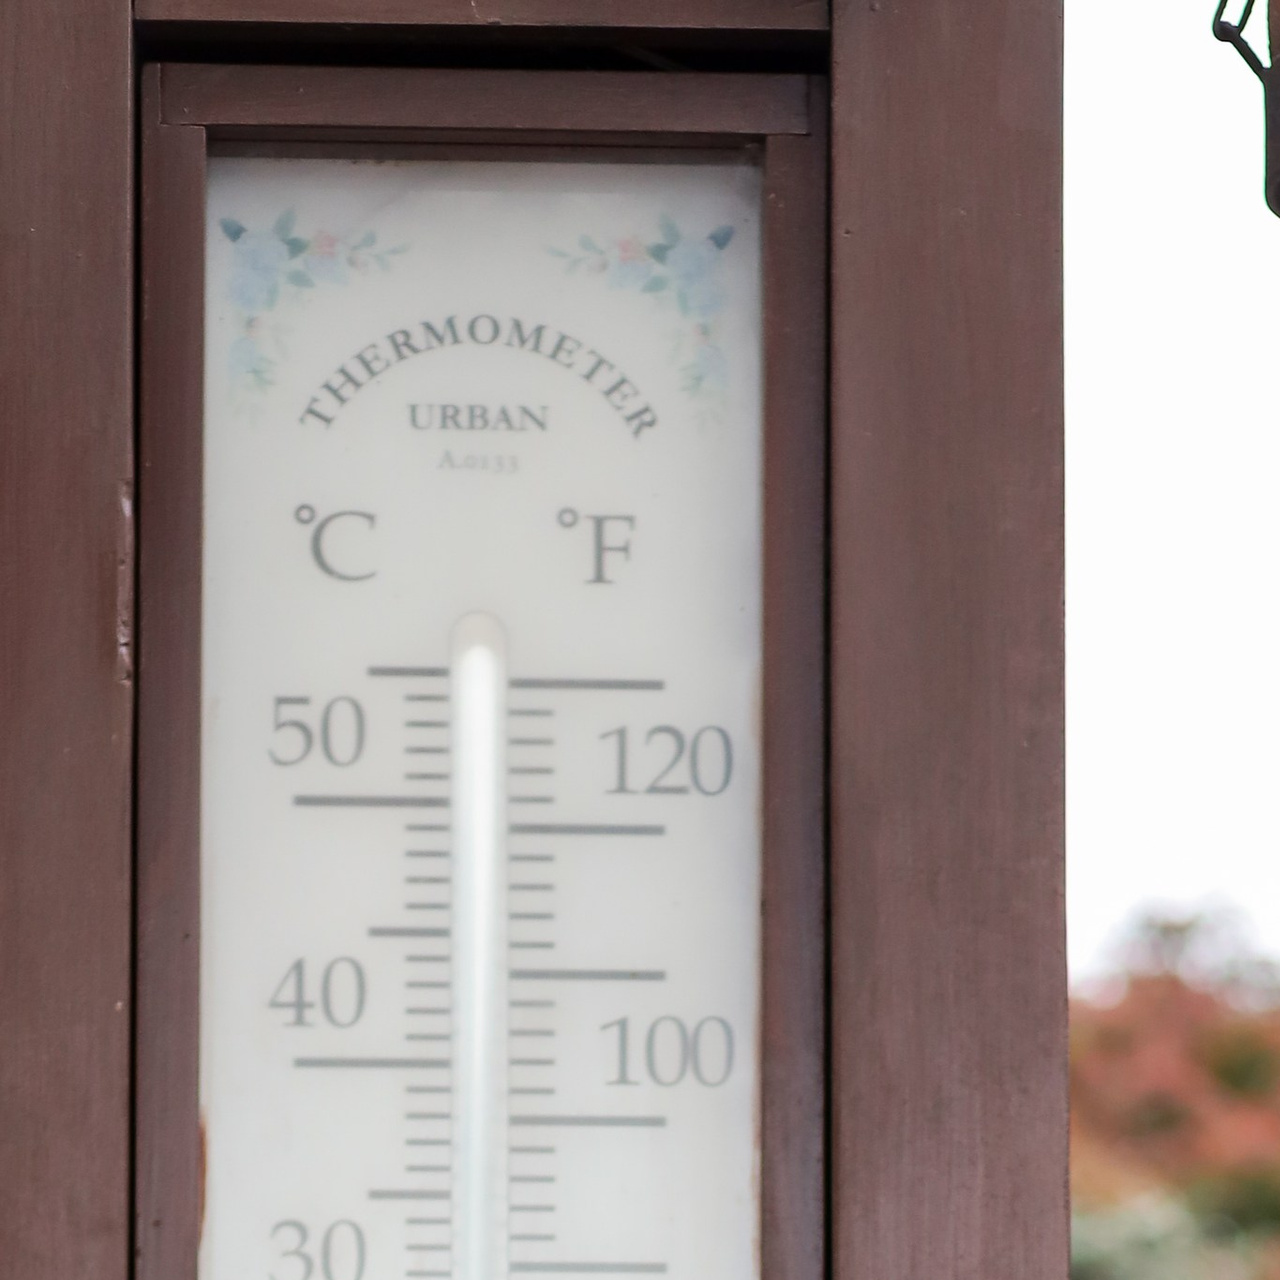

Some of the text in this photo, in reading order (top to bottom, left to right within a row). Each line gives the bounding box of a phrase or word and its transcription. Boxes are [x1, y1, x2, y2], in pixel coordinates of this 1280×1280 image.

[300, 314, 658, 438] THERMOMETER
[407, 402, 549, 432] URBAN
[292, 502, 377, 583] °C
[557, 506, 636, 584] °F
[268, 695, 367, 768] 50
[599, 723, 735, 798] 120
[267, 956, 368, 1030] 40
[599, 1015, 736, 1088] 100
